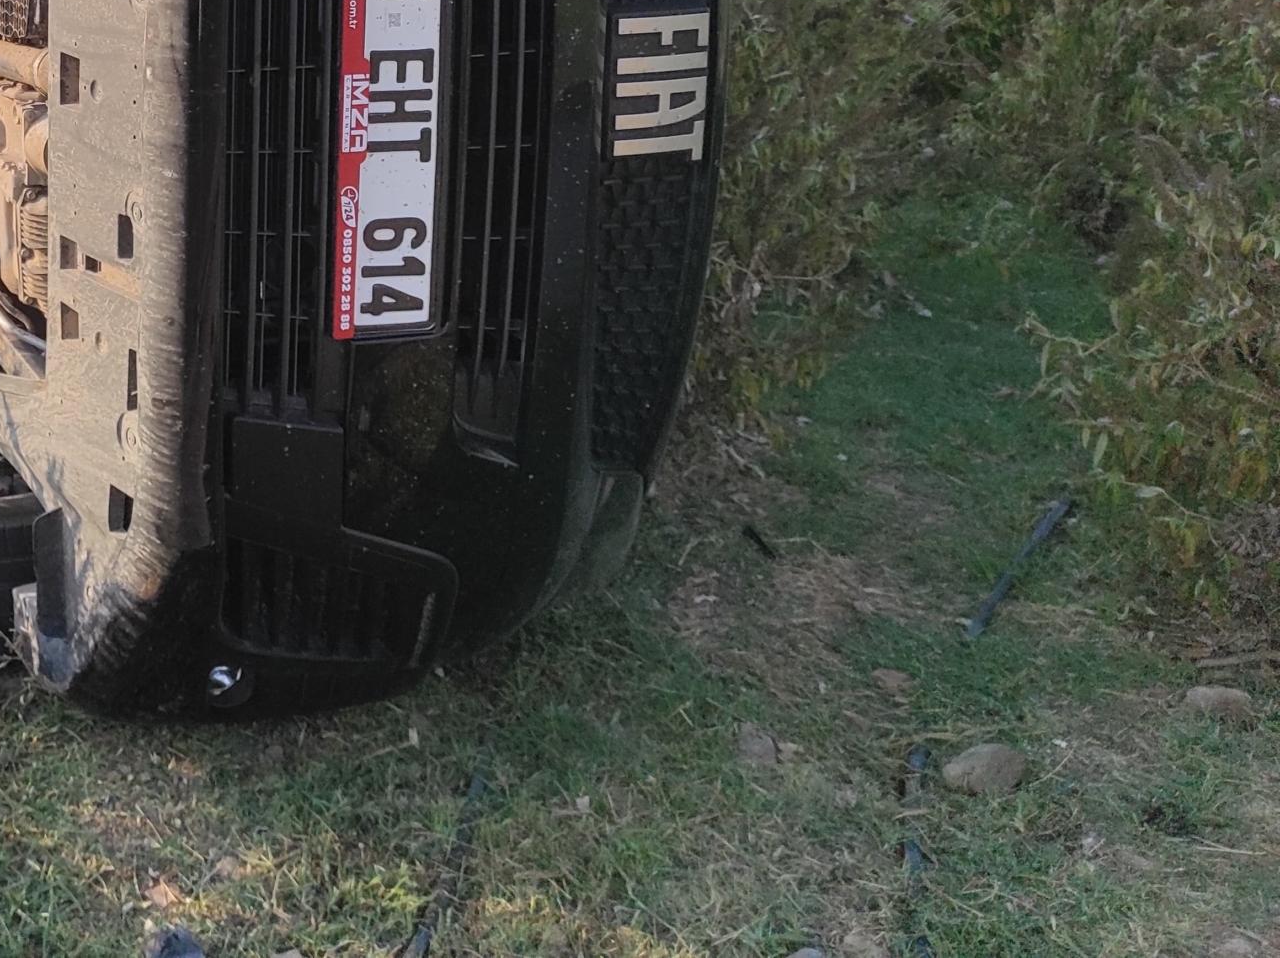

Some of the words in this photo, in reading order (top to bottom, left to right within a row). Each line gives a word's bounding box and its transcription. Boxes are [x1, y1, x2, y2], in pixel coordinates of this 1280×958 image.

[367, 48, 434, 163] EHT
[613, 12, 710, 161] FIAT
[341, 266, 352, 292] 302
[342, 229, 352, 264] 0850
[360, 217, 427, 316] 614
[341, 295, 351, 311] 28
